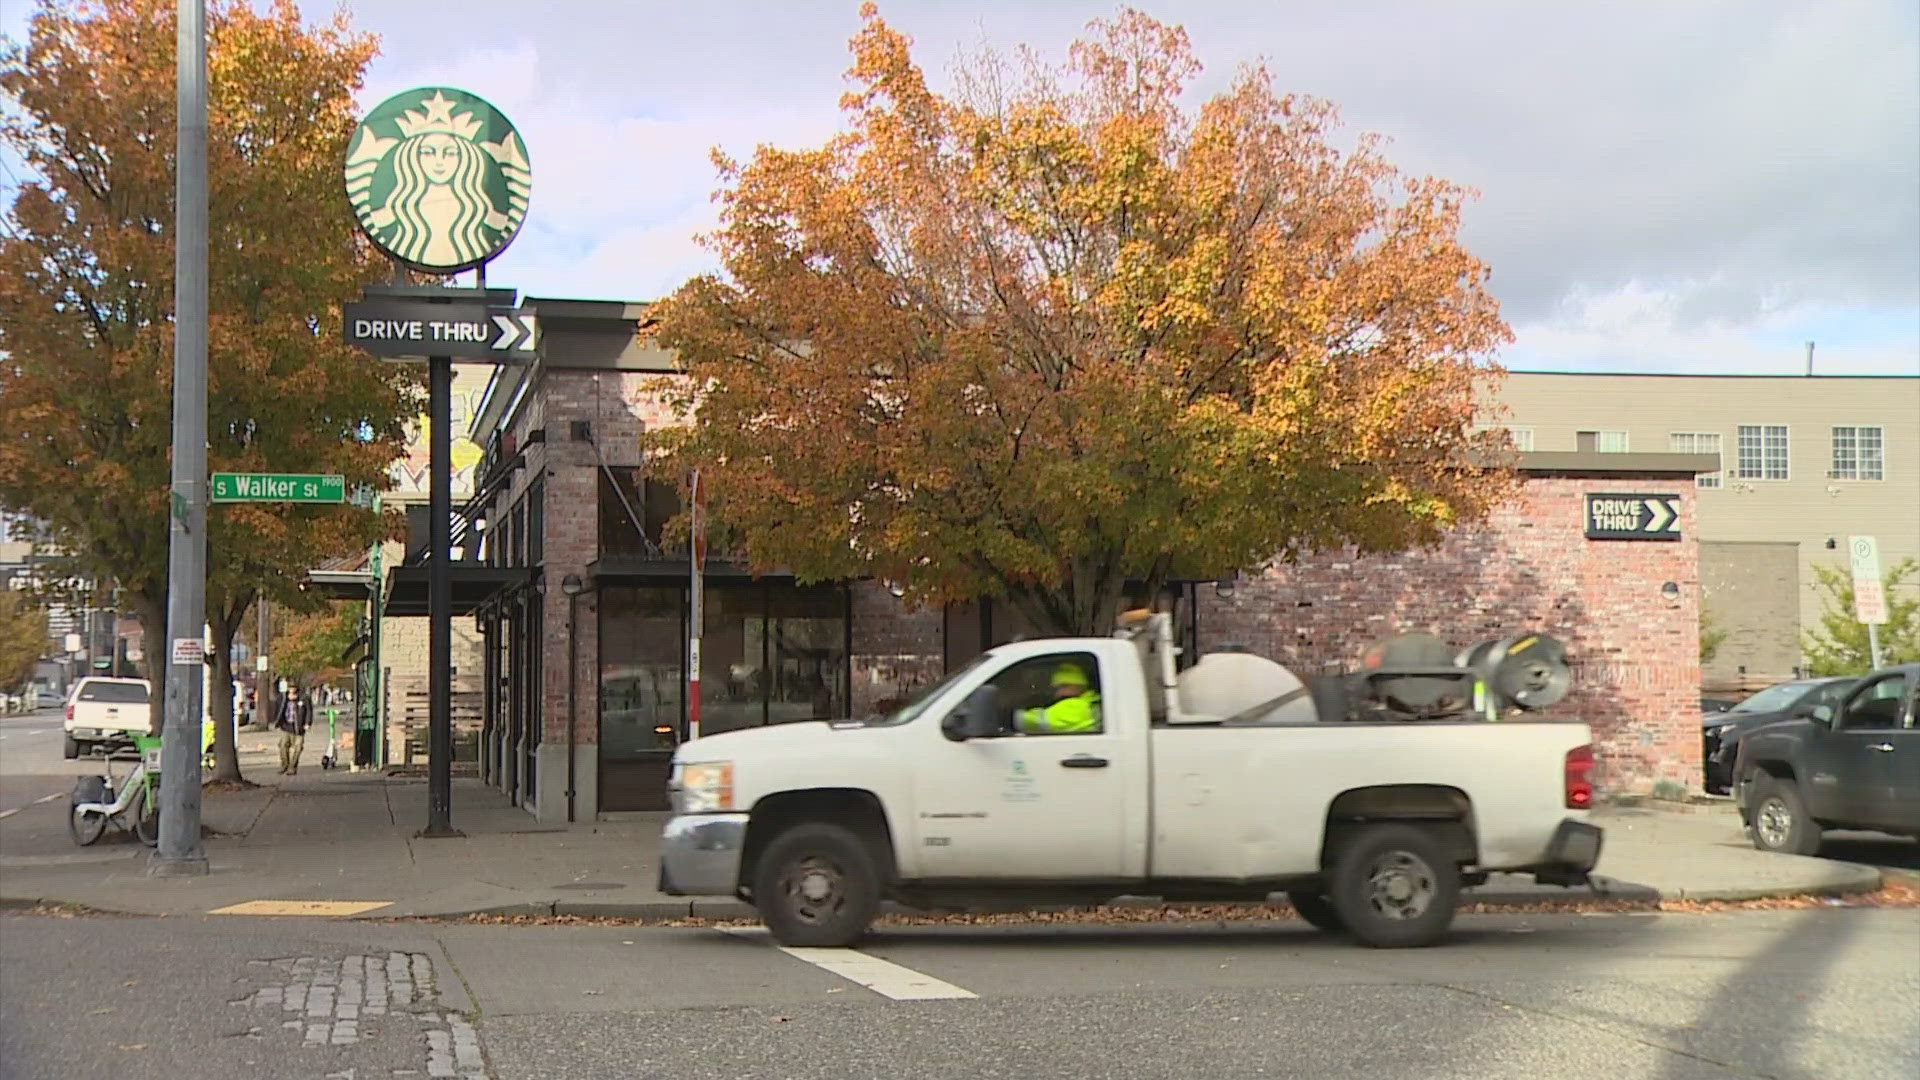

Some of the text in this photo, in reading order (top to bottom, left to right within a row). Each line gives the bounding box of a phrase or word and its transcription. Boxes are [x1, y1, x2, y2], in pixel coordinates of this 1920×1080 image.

[355, 320, 488, 342] DRIVE THRU
[235, 476, 297, 497] Walker
[303, 482, 319, 497] St
[321, 477, 342, 487] 1900
[1592, 499, 1642, 515] DRIVE
[1592, 515, 1638, 531] THRU
